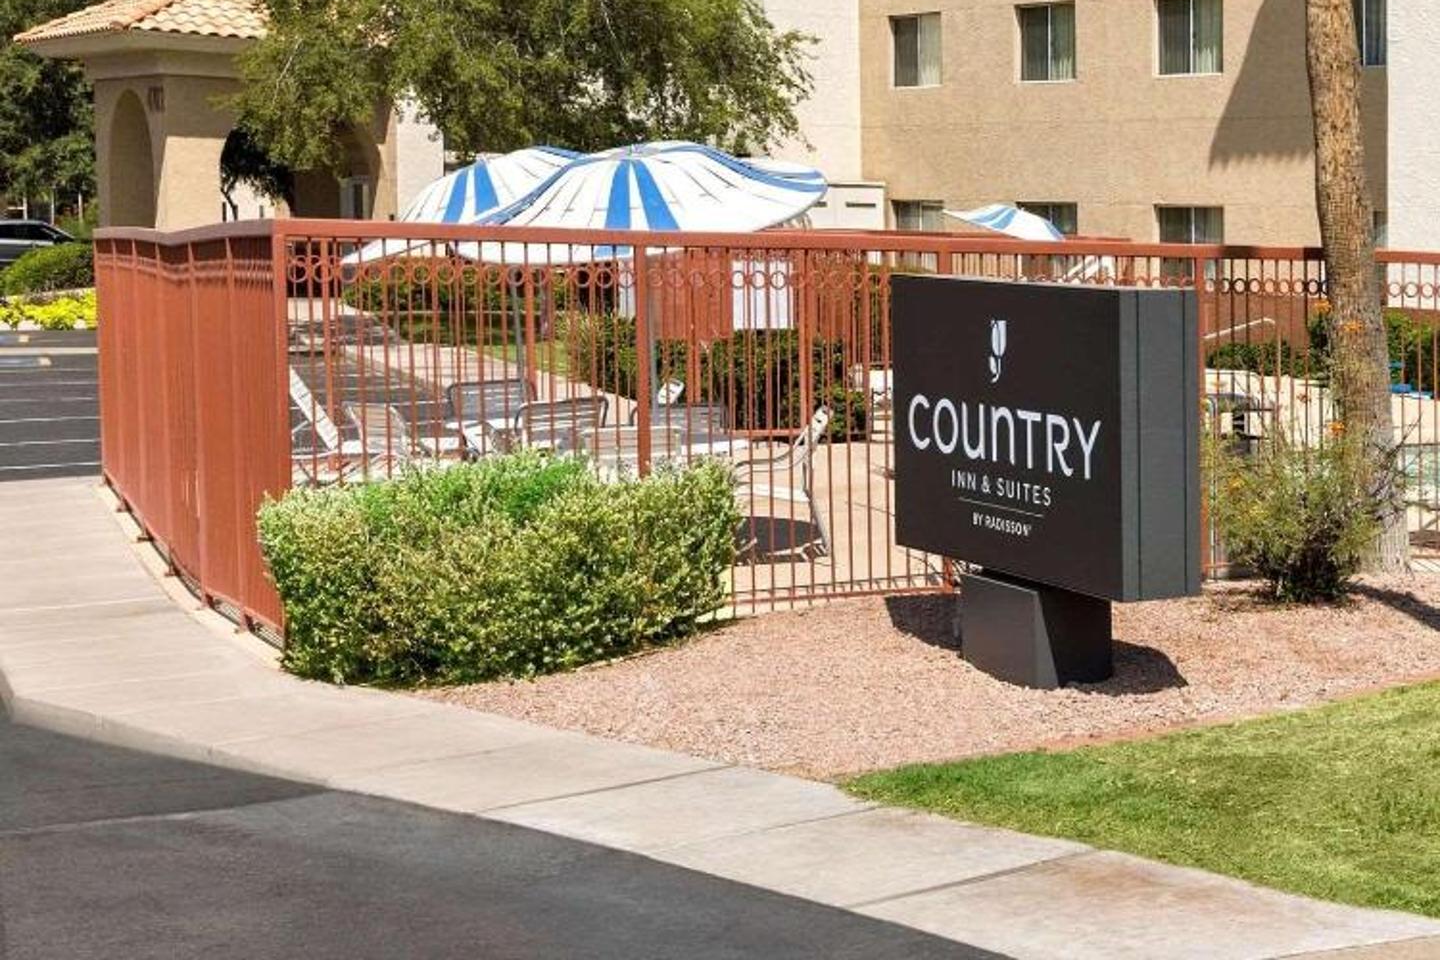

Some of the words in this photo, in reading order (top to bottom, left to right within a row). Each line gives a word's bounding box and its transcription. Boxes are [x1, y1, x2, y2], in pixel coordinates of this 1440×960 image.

[908, 394, 1102, 480] COUNTRY
[951, 469, 976, 491] INN
[981, 474, 991, 494] &
[996, 477, 1051, 507] SUITES
[972, 512, 984, 526] BY
